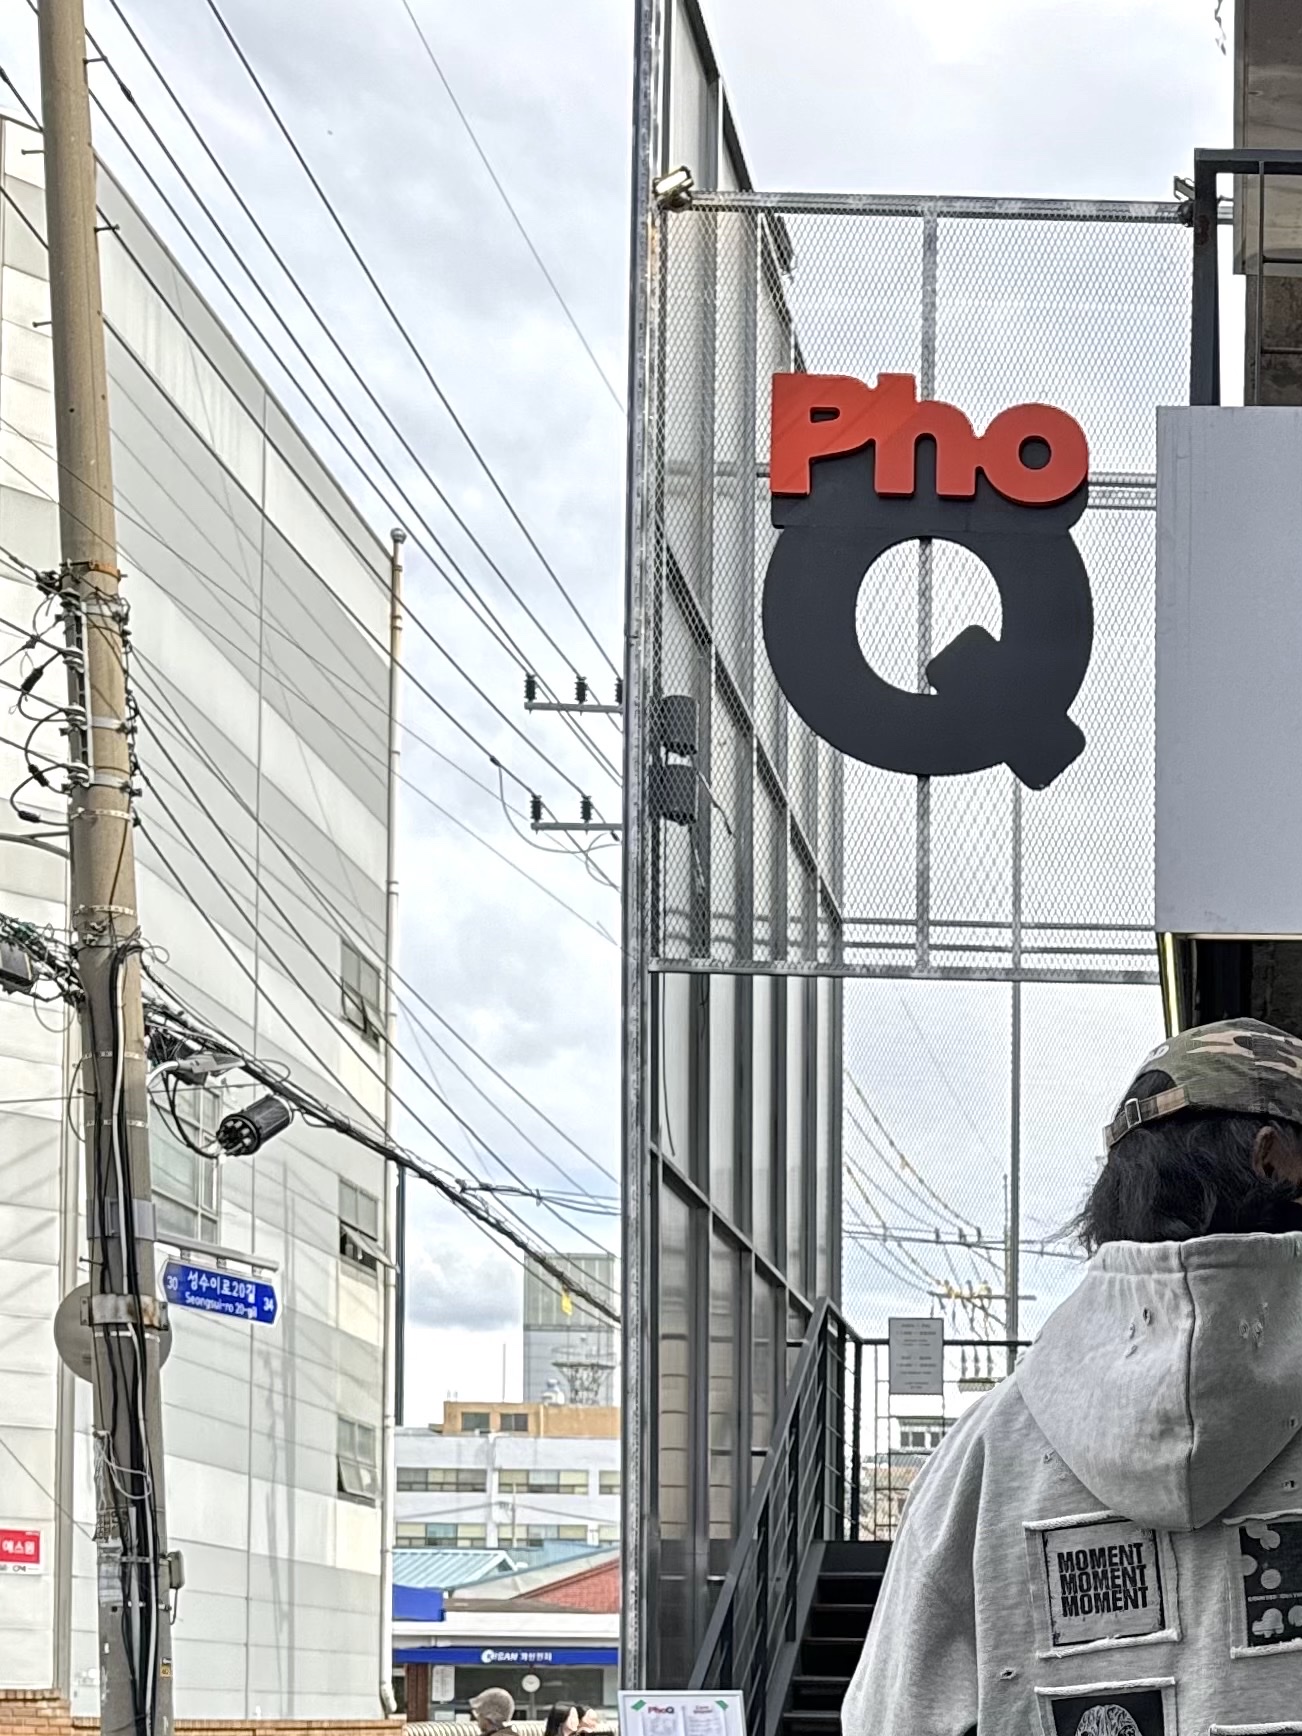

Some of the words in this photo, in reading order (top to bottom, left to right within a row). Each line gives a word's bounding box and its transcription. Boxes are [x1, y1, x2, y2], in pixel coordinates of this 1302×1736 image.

[770, 372, 1089, 506] Pho
[762, 502, 1094, 790] Q
[167, 1275, 178, 1291] 30
[187, 1270, 256, 1304] 성수이로20길
[263, 1296, 275, 1313] 34
[1057, 1543, 1143, 1574] MOMENT
[1060, 1564, 1147, 1596] MOMENT
[1061, 1586, 1148, 1617] MOMENT
